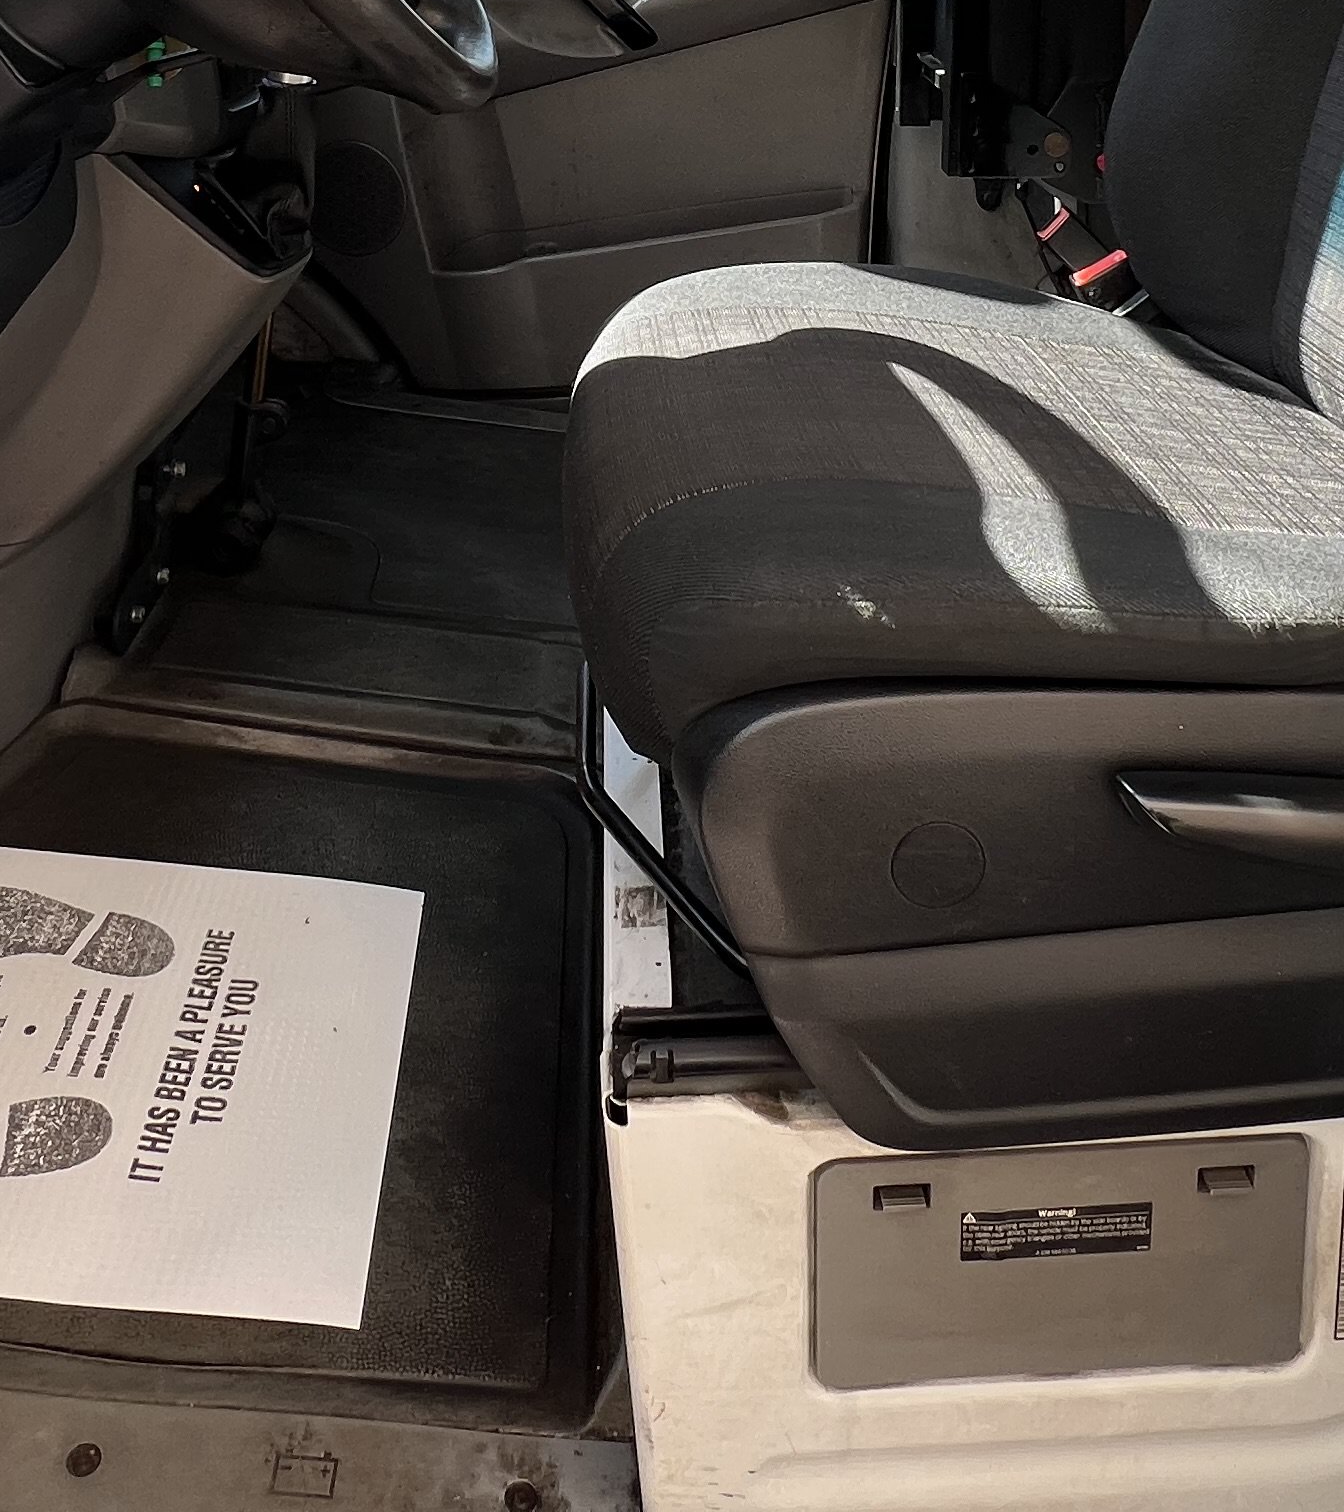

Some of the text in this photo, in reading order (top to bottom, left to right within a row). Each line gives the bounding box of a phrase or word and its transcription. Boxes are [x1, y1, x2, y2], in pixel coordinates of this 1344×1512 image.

[42, 1052, 61, 1073] Your
[128, 928, 236, 1183] IT HAS BEEN A PLEASURE
[189, 978, 260, 1126] TO SERVE YOU
[1038, 1208, 1076, 1218] Warning!
